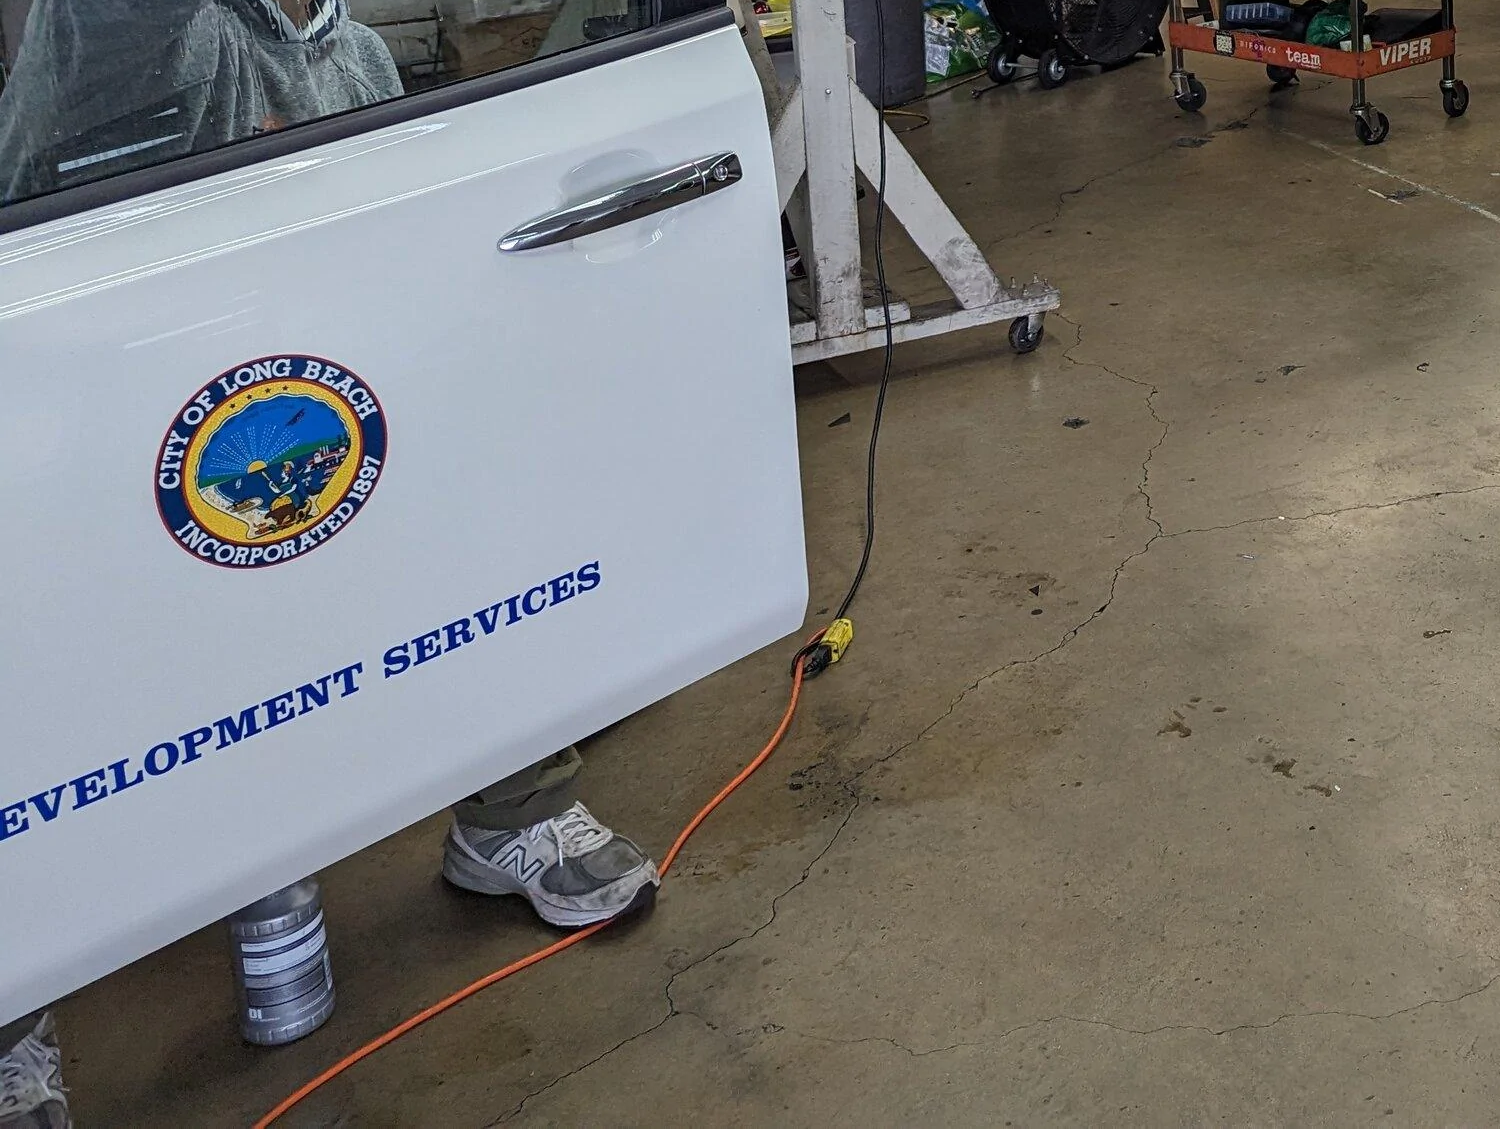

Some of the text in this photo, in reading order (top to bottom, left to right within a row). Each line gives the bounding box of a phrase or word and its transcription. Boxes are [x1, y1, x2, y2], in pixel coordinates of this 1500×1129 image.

[1285, 47, 1321, 66] team
[1380, 37, 1431, 66] VIPER
[159, 358, 379, 490] CITY OF LONG BEACH
[174, 455, 382, 566] INCORPORATED 1897
[0, 560, 602, 842] EVELOPMENT SERVICES
